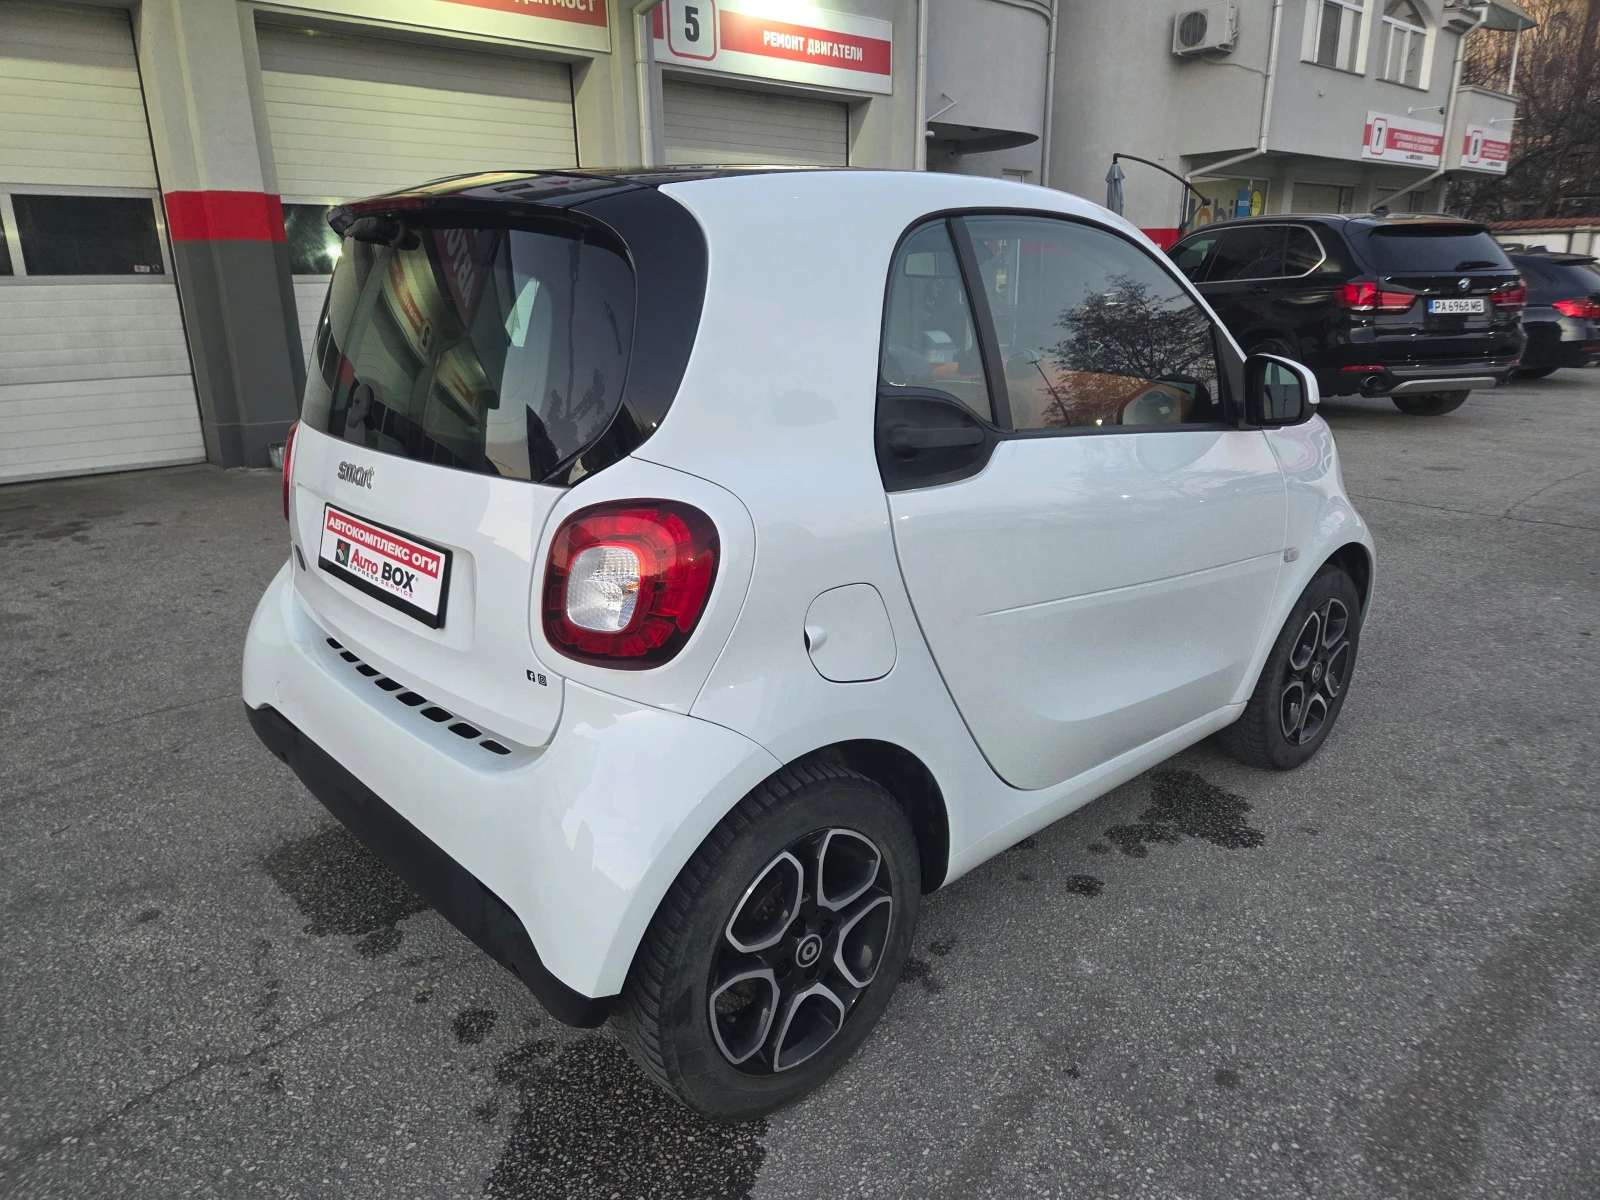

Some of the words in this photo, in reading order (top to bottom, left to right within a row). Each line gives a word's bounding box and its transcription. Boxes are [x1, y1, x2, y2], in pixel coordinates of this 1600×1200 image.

[684, 5, 700, 42] 5
[763, 30, 805, 51] РЕМОНТ
[807, 38, 863, 61] ДВИГАТЕЛИ
[1375, 127, 1383, 146] 7
[1434, 301, 1447, 312] PA
[1448, 301, 1469, 312] 6968
[337, 461, 375, 489] smart
[328, 516, 411, 561] АВТОКОМПЛЕКС
[411, 552, 438, 574] ОГИ
[349, 564, 379, 582] EXPRESS
[380, 579, 414, 599] SERVICE
[381, 561, 416, 593] BOX
